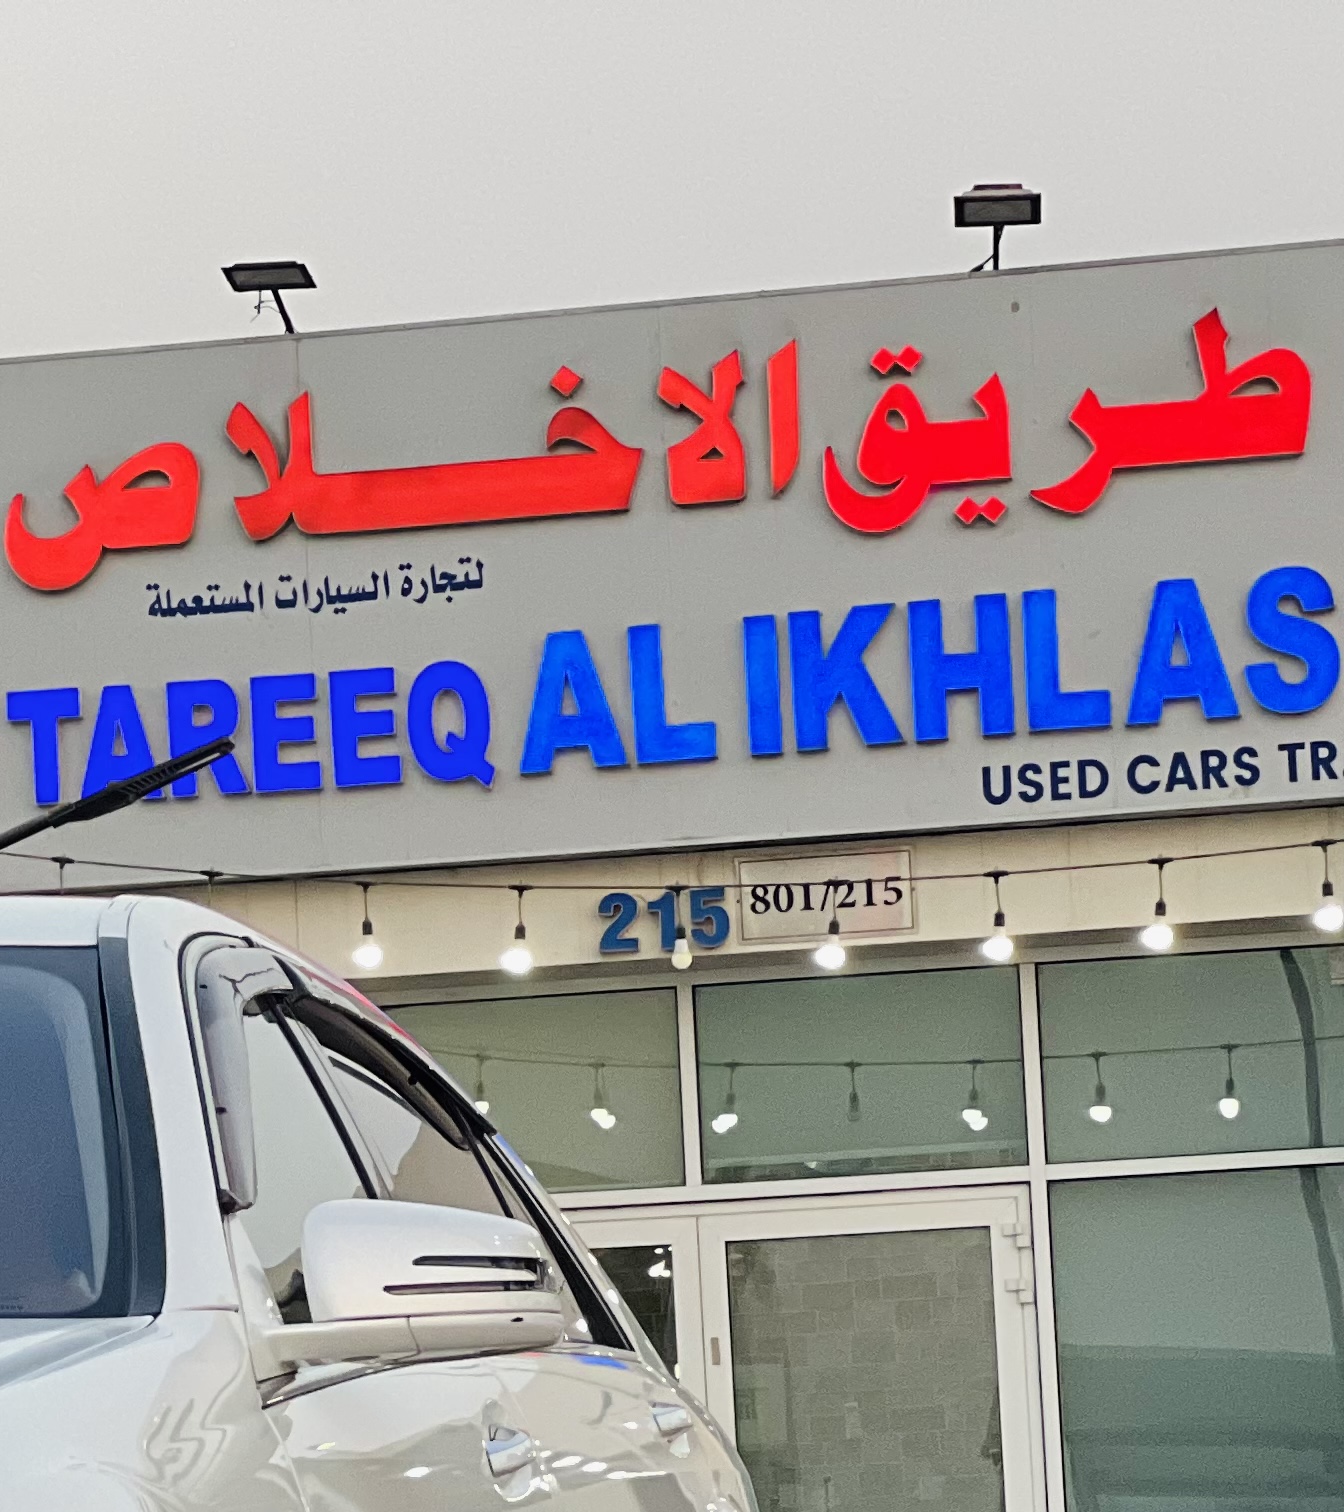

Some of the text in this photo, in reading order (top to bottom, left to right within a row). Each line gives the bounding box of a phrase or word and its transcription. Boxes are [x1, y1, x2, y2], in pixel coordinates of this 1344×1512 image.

[3, 306, 1311, 590] طريق الاخلاص
[146, 556, 485, 617] لتجارة السيارات المستعملة
[6, 565, 1341, 806] TAREEQ AL IKHLAS
[981, 740, 1344, 805] USED CARS TR
[598, 886, 730, 954] 215
[750, 876, 903, 914] 801/215
